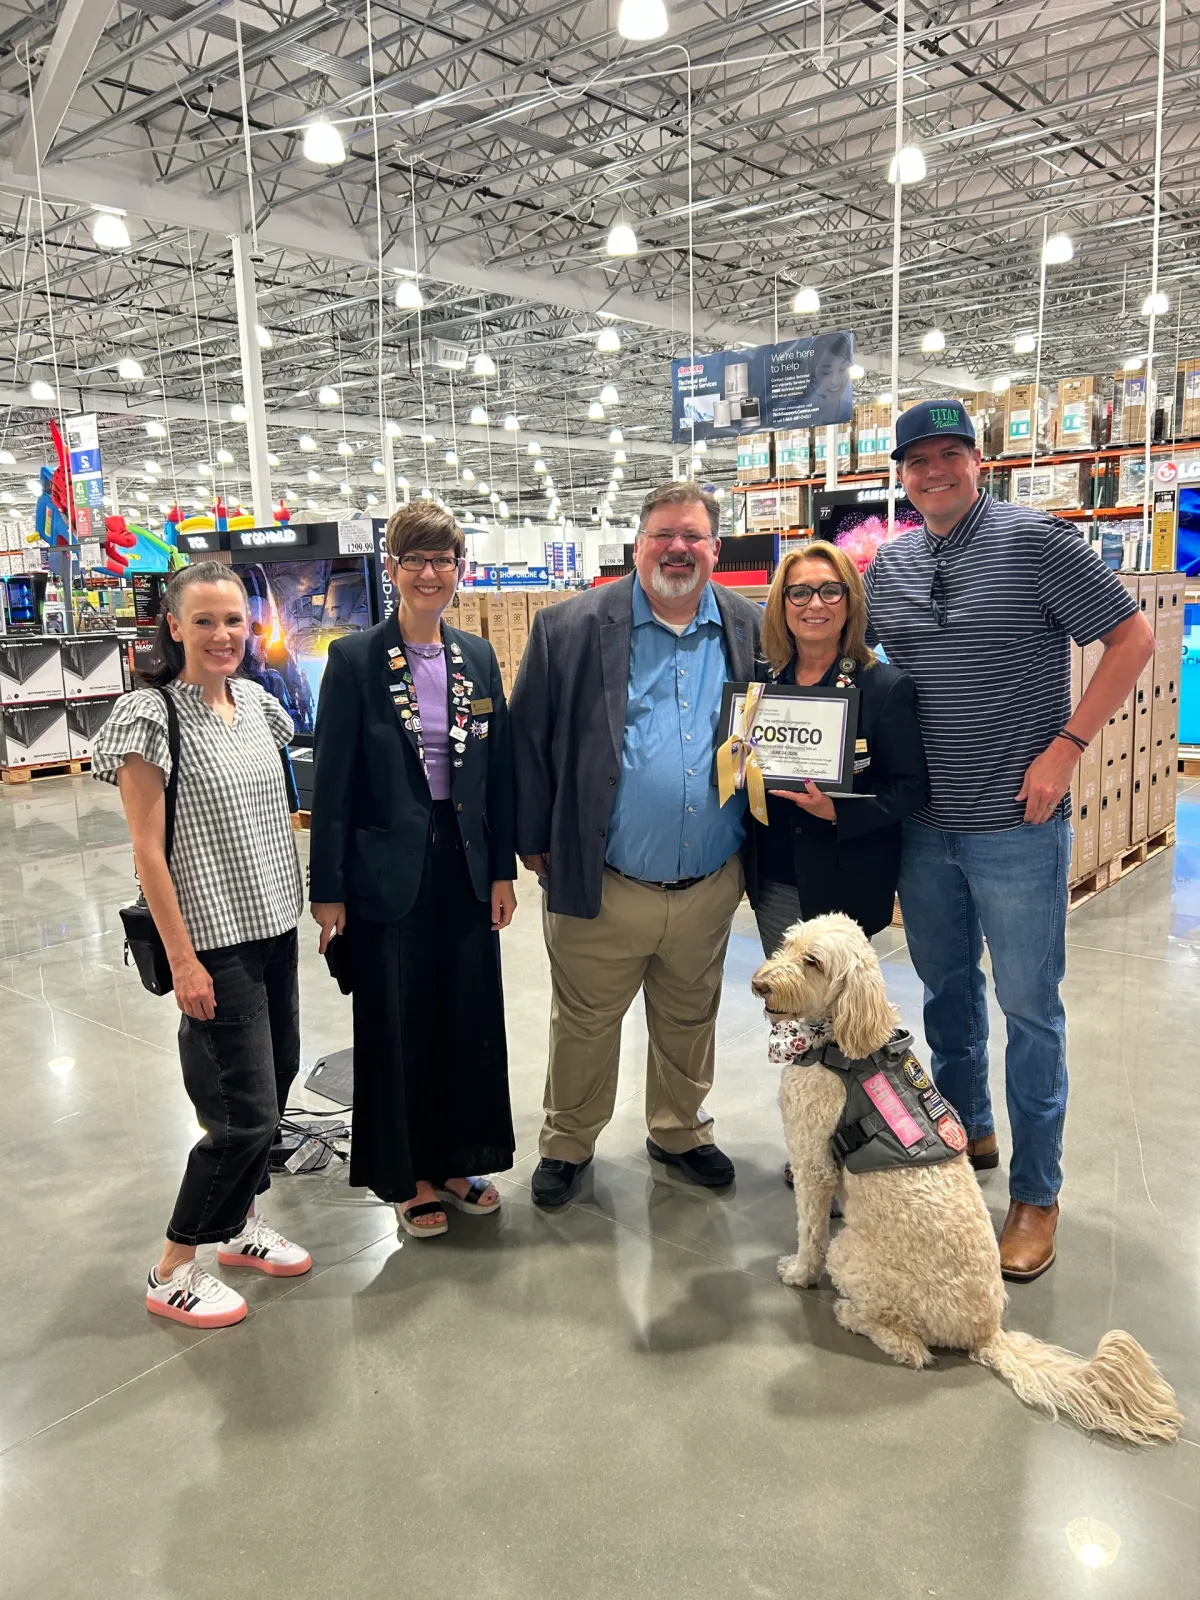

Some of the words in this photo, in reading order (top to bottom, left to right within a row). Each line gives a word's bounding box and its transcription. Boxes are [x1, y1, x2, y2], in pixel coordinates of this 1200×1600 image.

[771, 352, 795, 362] We're
[796, 350, 815, 359] here
[771, 365, 780, 373] to
[781, 362, 800, 371] help
[699, 381, 718, 389] Services
[930, 409, 959, 421] TITAN
[1178, 462, 1200, 479] LG
[347, 541, 373, 553] 1299.99
[516, 570, 537, 579] ONLINE
[752, 725, 822, 745] COSTCO
[868, 1078, 905, 1122] SERVICE
